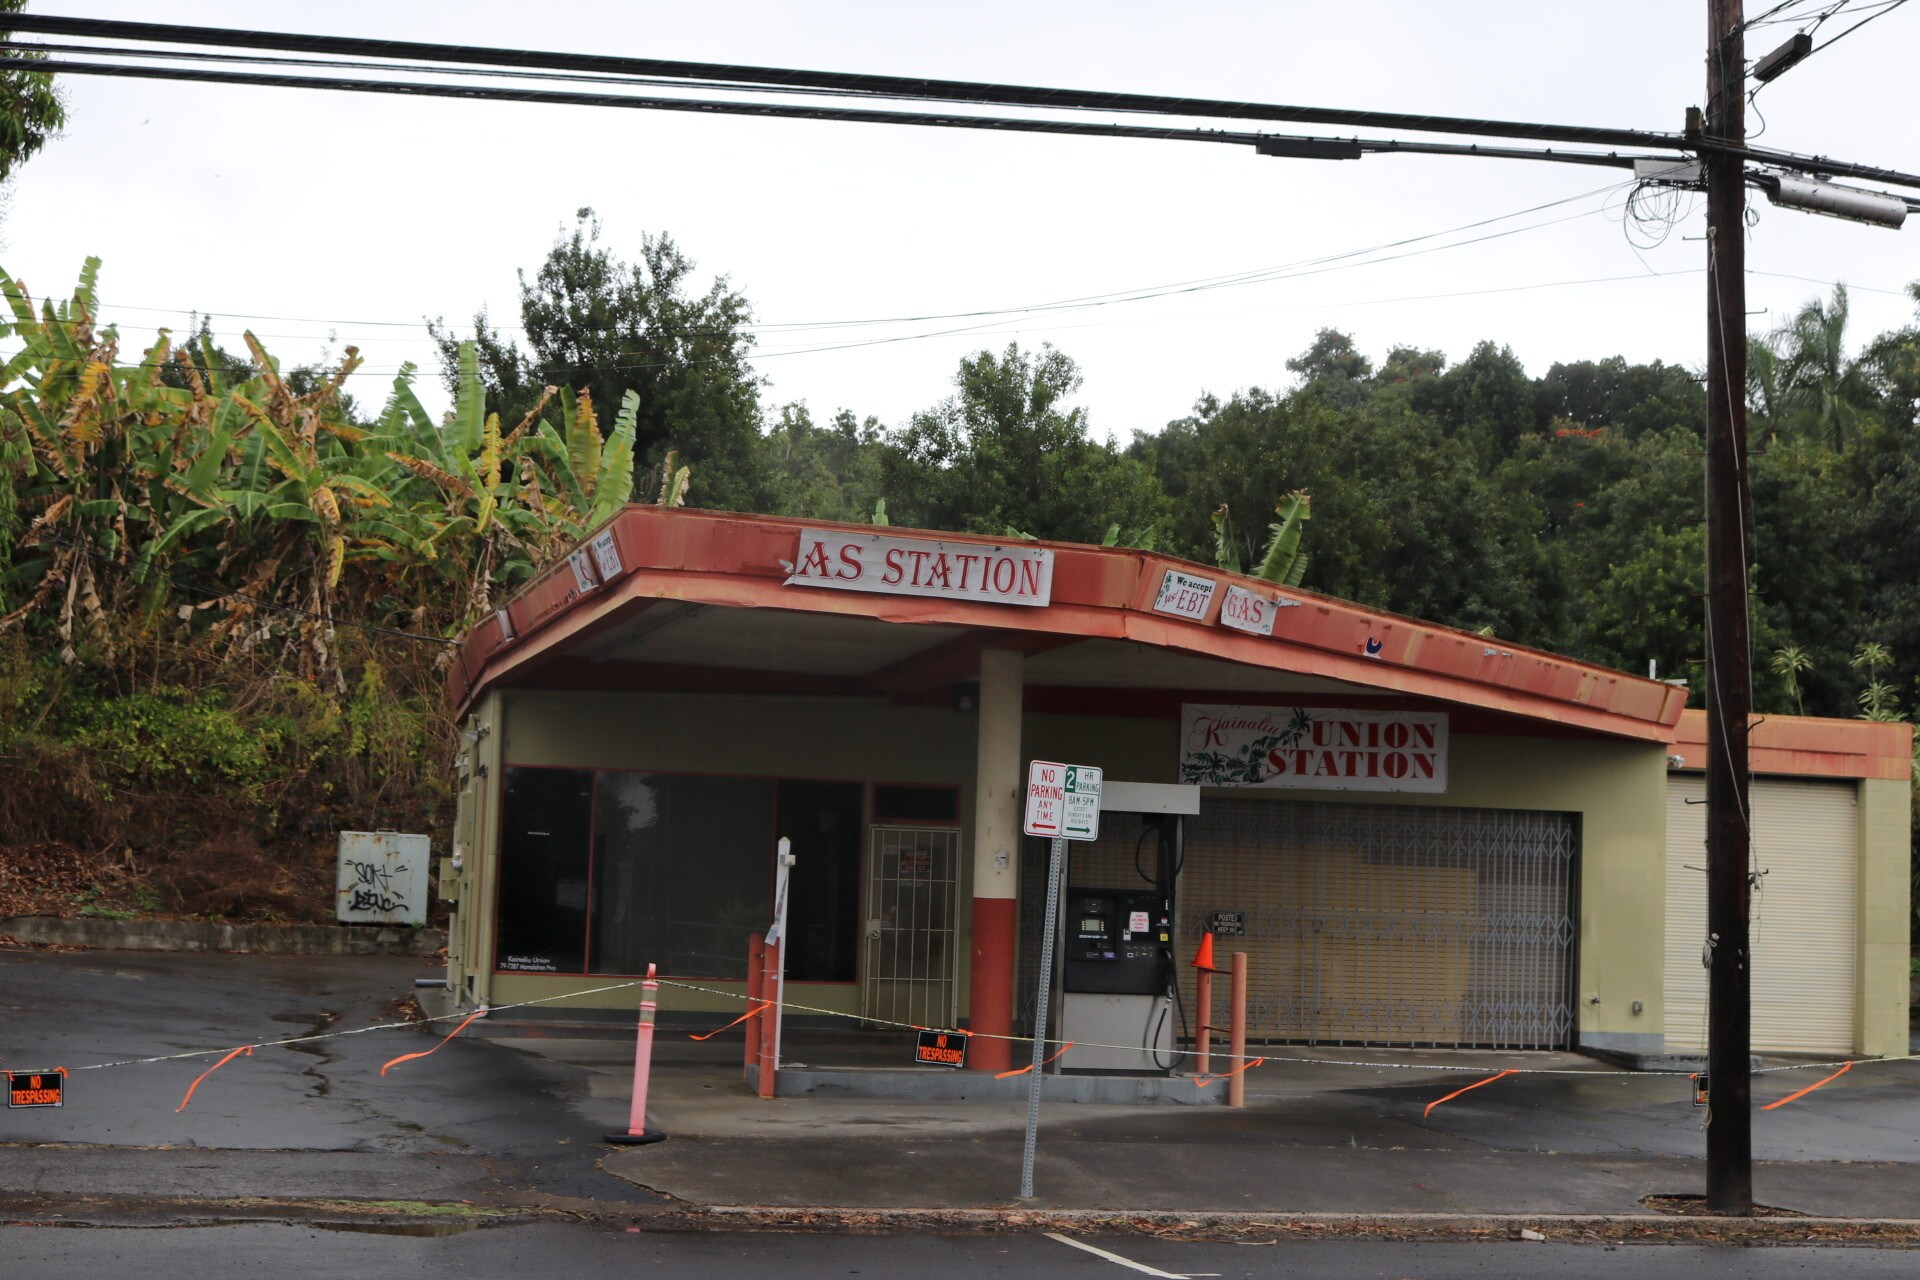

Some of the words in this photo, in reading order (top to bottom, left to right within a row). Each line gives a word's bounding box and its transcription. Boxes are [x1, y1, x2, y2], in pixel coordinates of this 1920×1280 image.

[797, 541, 864, 581] AS
[881, 549, 1044, 598] STATION
[1176, 576, 1188, 586] We
[1188, 582, 1212, 593] accept
[1176, 590, 1208, 614] EBT
[1228, 594, 1264, 624] GAS
[1188, 712, 1280, 751] Kainaliu
[1310, 720, 1438, 749] UNION
[1266, 748, 1438, 779] STATION
[1041, 768, 1056, 783] NO
[1066, 770, 1076, 789] 2
[1084, 772, 1094, 780] HR
[1031, 784, 1063, 800] PARKING
[1076, 782, 1099, 792] PARKING
[1038, 800, 1053, 810] ANY
[1036, 811, 1054, 821] TIME
[937, 1034, 947, 1048] NO
[918, 1046, 962, 1063] TRESPASSING
[31, 1075, 41, 1089] NO
[12, 1089, 60, 1104] TRESPASSING
